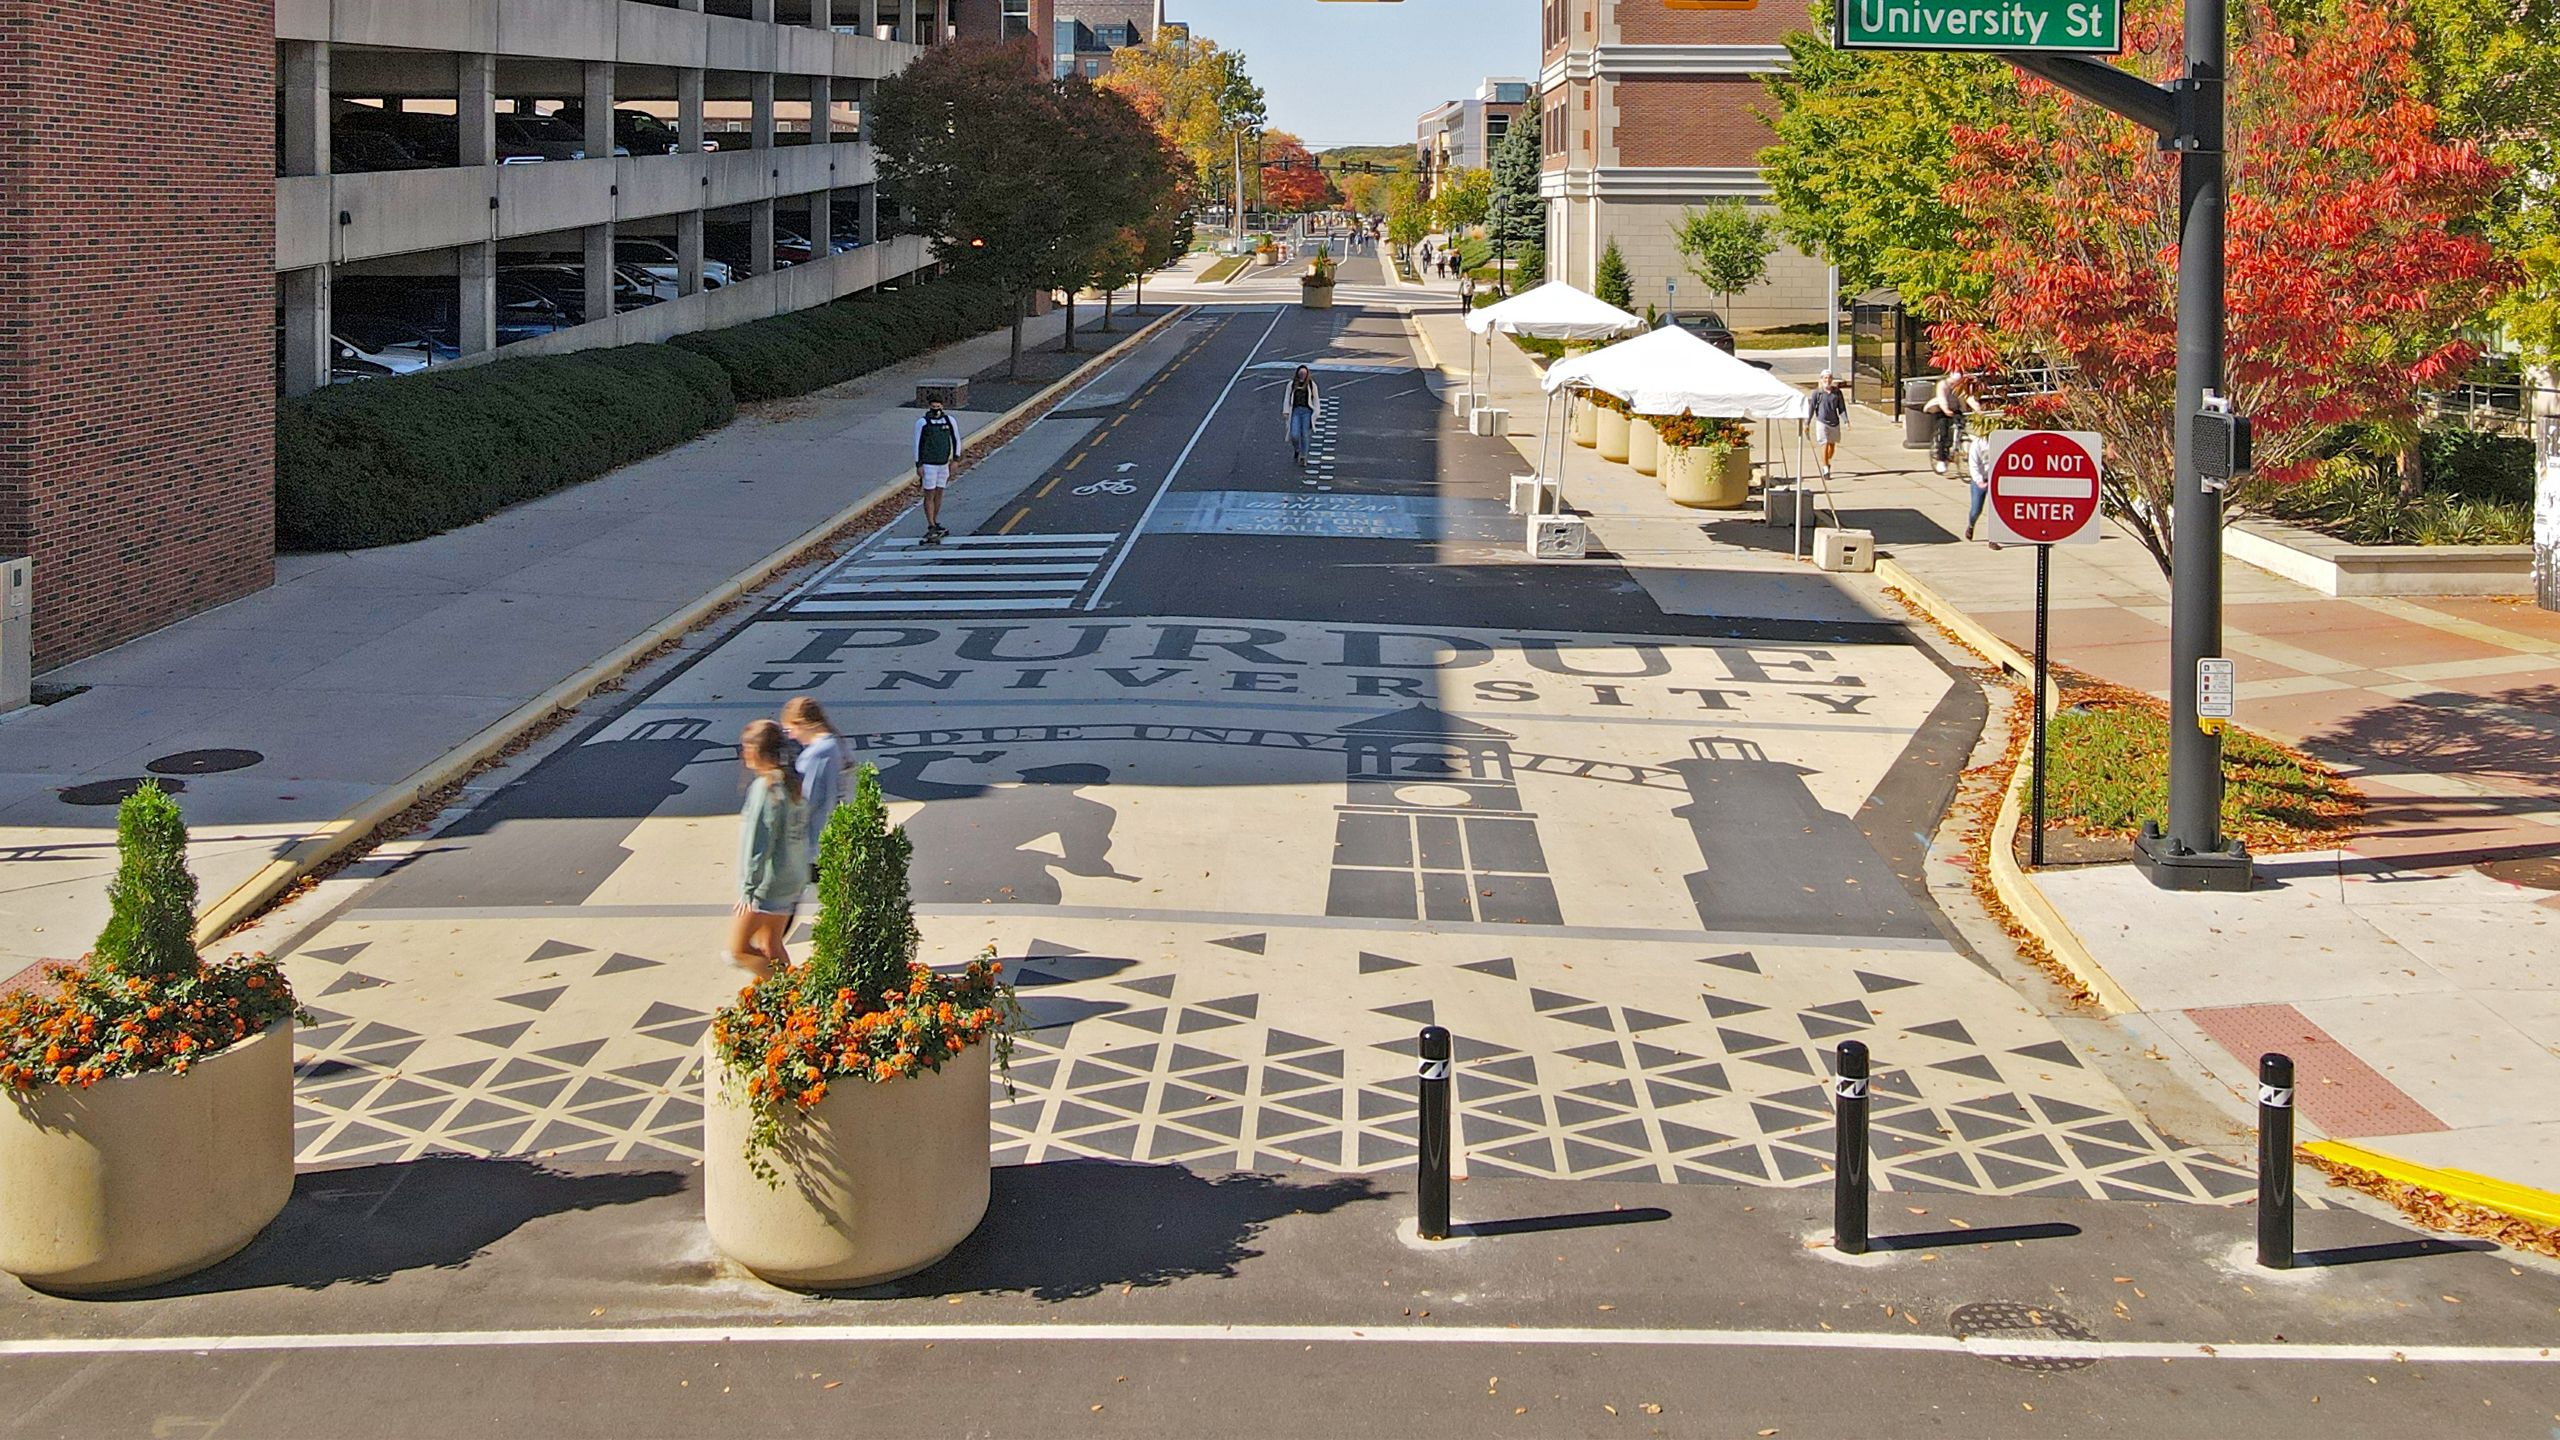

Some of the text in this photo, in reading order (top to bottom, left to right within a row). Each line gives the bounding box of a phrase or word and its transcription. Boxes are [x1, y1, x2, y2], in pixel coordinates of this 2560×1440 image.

[1860, 0, 2104, 45] University St
[2008, 453, 2084, 472] DO NOT
[1329, 503, 1397, 512] LEAP
[2014, 503, 2075, 521] ENTER
[1236, 523, 1329, 533] SMALL
[1254, 516, 1387, 527] WITH ONE
[766, 623, 1867, 687] PURDUE
[747, 667, 1877, 715] UNIVERSITY
